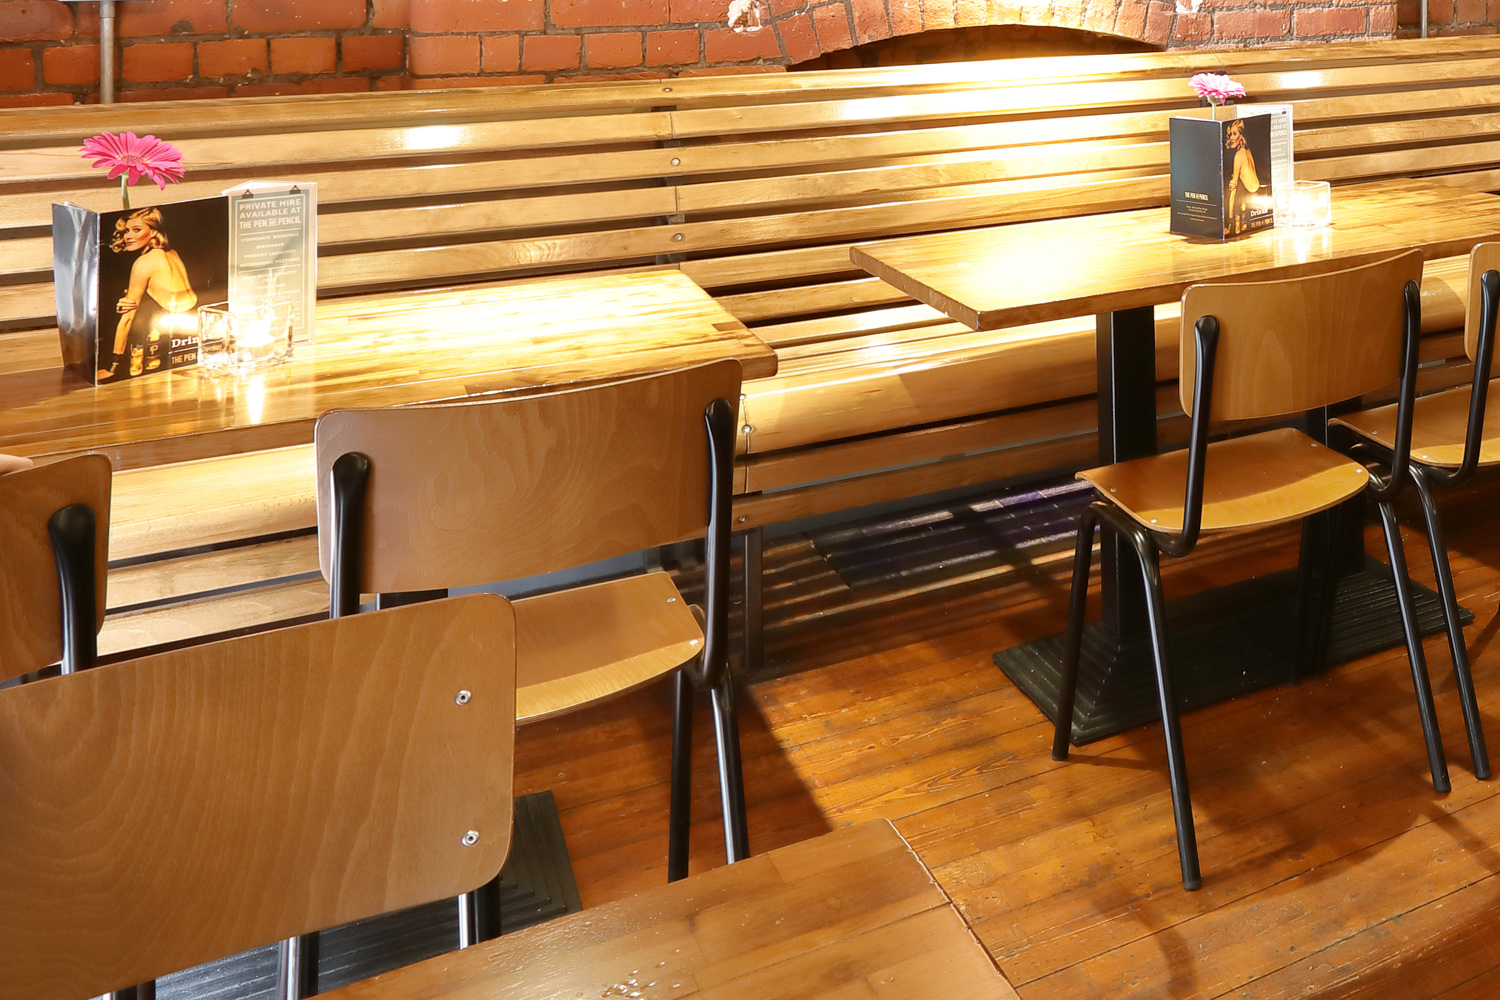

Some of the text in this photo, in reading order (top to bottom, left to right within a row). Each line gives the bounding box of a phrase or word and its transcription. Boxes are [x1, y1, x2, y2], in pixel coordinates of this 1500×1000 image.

[239, 198, 301, 211] PRIVATE HIRE
[239, 206, 301, 219] AVAILABLE AT
[239, 220, 252, 230] THE
[253, 218, 267, 228] PEN
[278, 215, 301, 226] PENCIL
[171, 352, 197, 364] THE PEN
